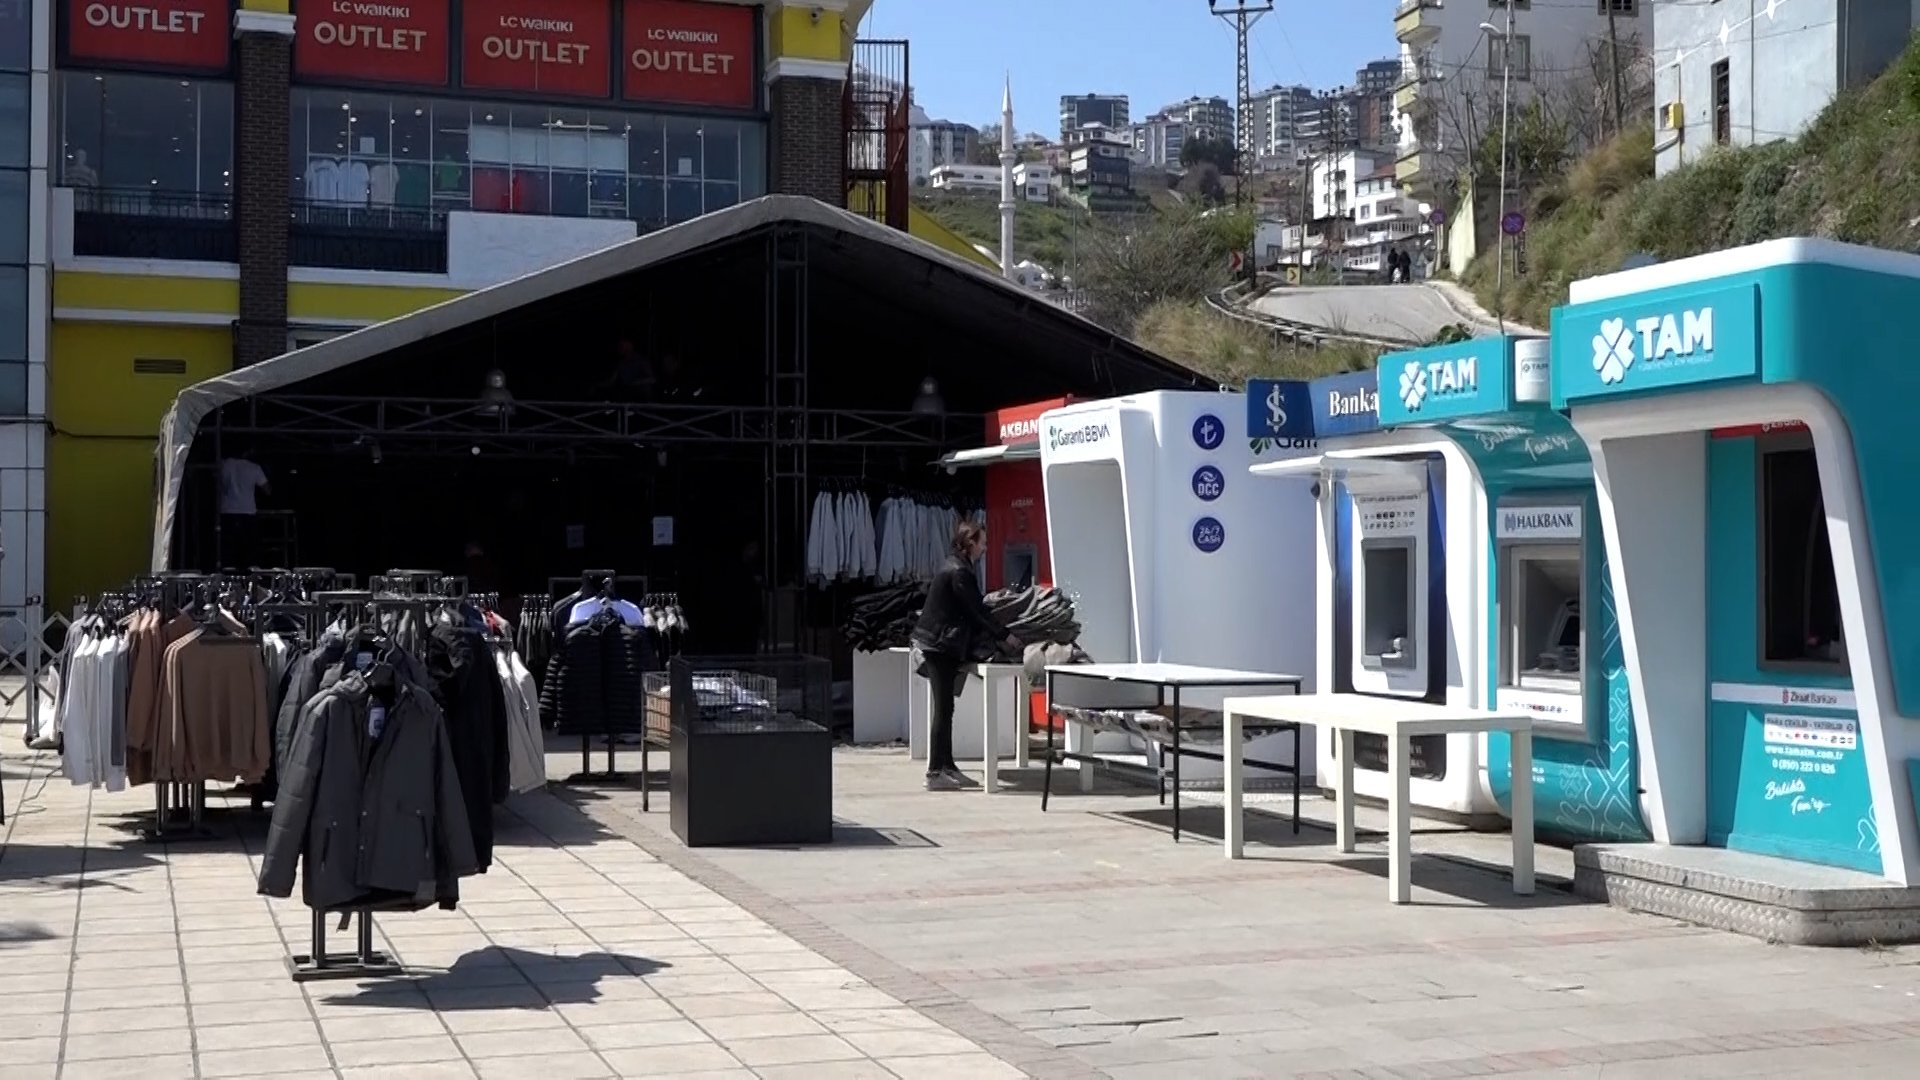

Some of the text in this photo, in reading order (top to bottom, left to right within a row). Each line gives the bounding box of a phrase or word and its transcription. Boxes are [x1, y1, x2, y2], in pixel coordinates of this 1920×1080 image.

[85, 3, 205, 33] OUTLET
[333, 1, 351, 13] LC
[500, 16, 518, 28] LC
[314, 21, 427, 52] OUTLET
[647, 29, 666, 40] LC
[482, 36, 590, 64] OUTLET
[631, 49, 735, 74] OUTLET
[1636, 307, 1714, 361] TAM
[1427, 356, 1478, 392] TAM
[1057, 424, 1111, 446] Garanti BBVA
[1198, 483, 1220, 496] DCC
[1516, 512, 1574, 529] HALKBANK
